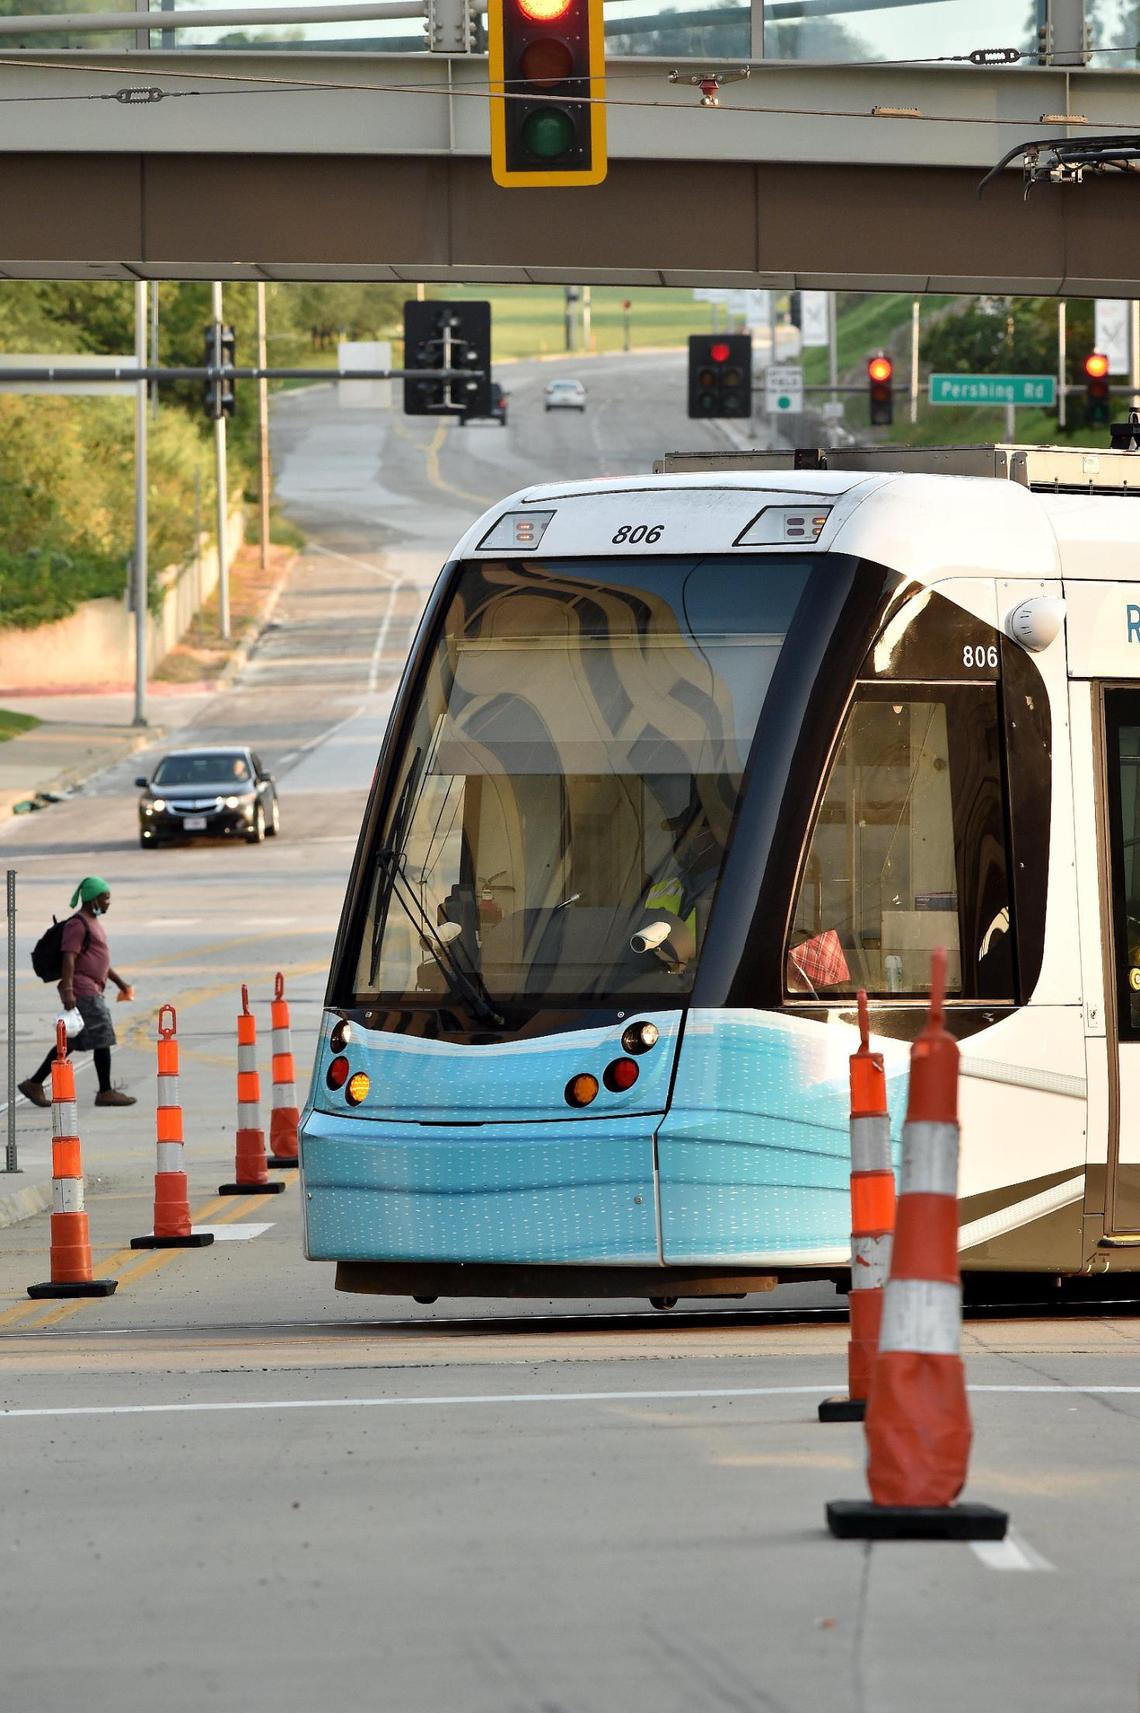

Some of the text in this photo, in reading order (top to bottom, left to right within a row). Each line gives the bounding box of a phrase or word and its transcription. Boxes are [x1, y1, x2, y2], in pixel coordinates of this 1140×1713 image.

[941, 381, 1045, 400] Pershing Rd
[611, 524, 665, 545] 806
[962, 645, 998, 668] 806
